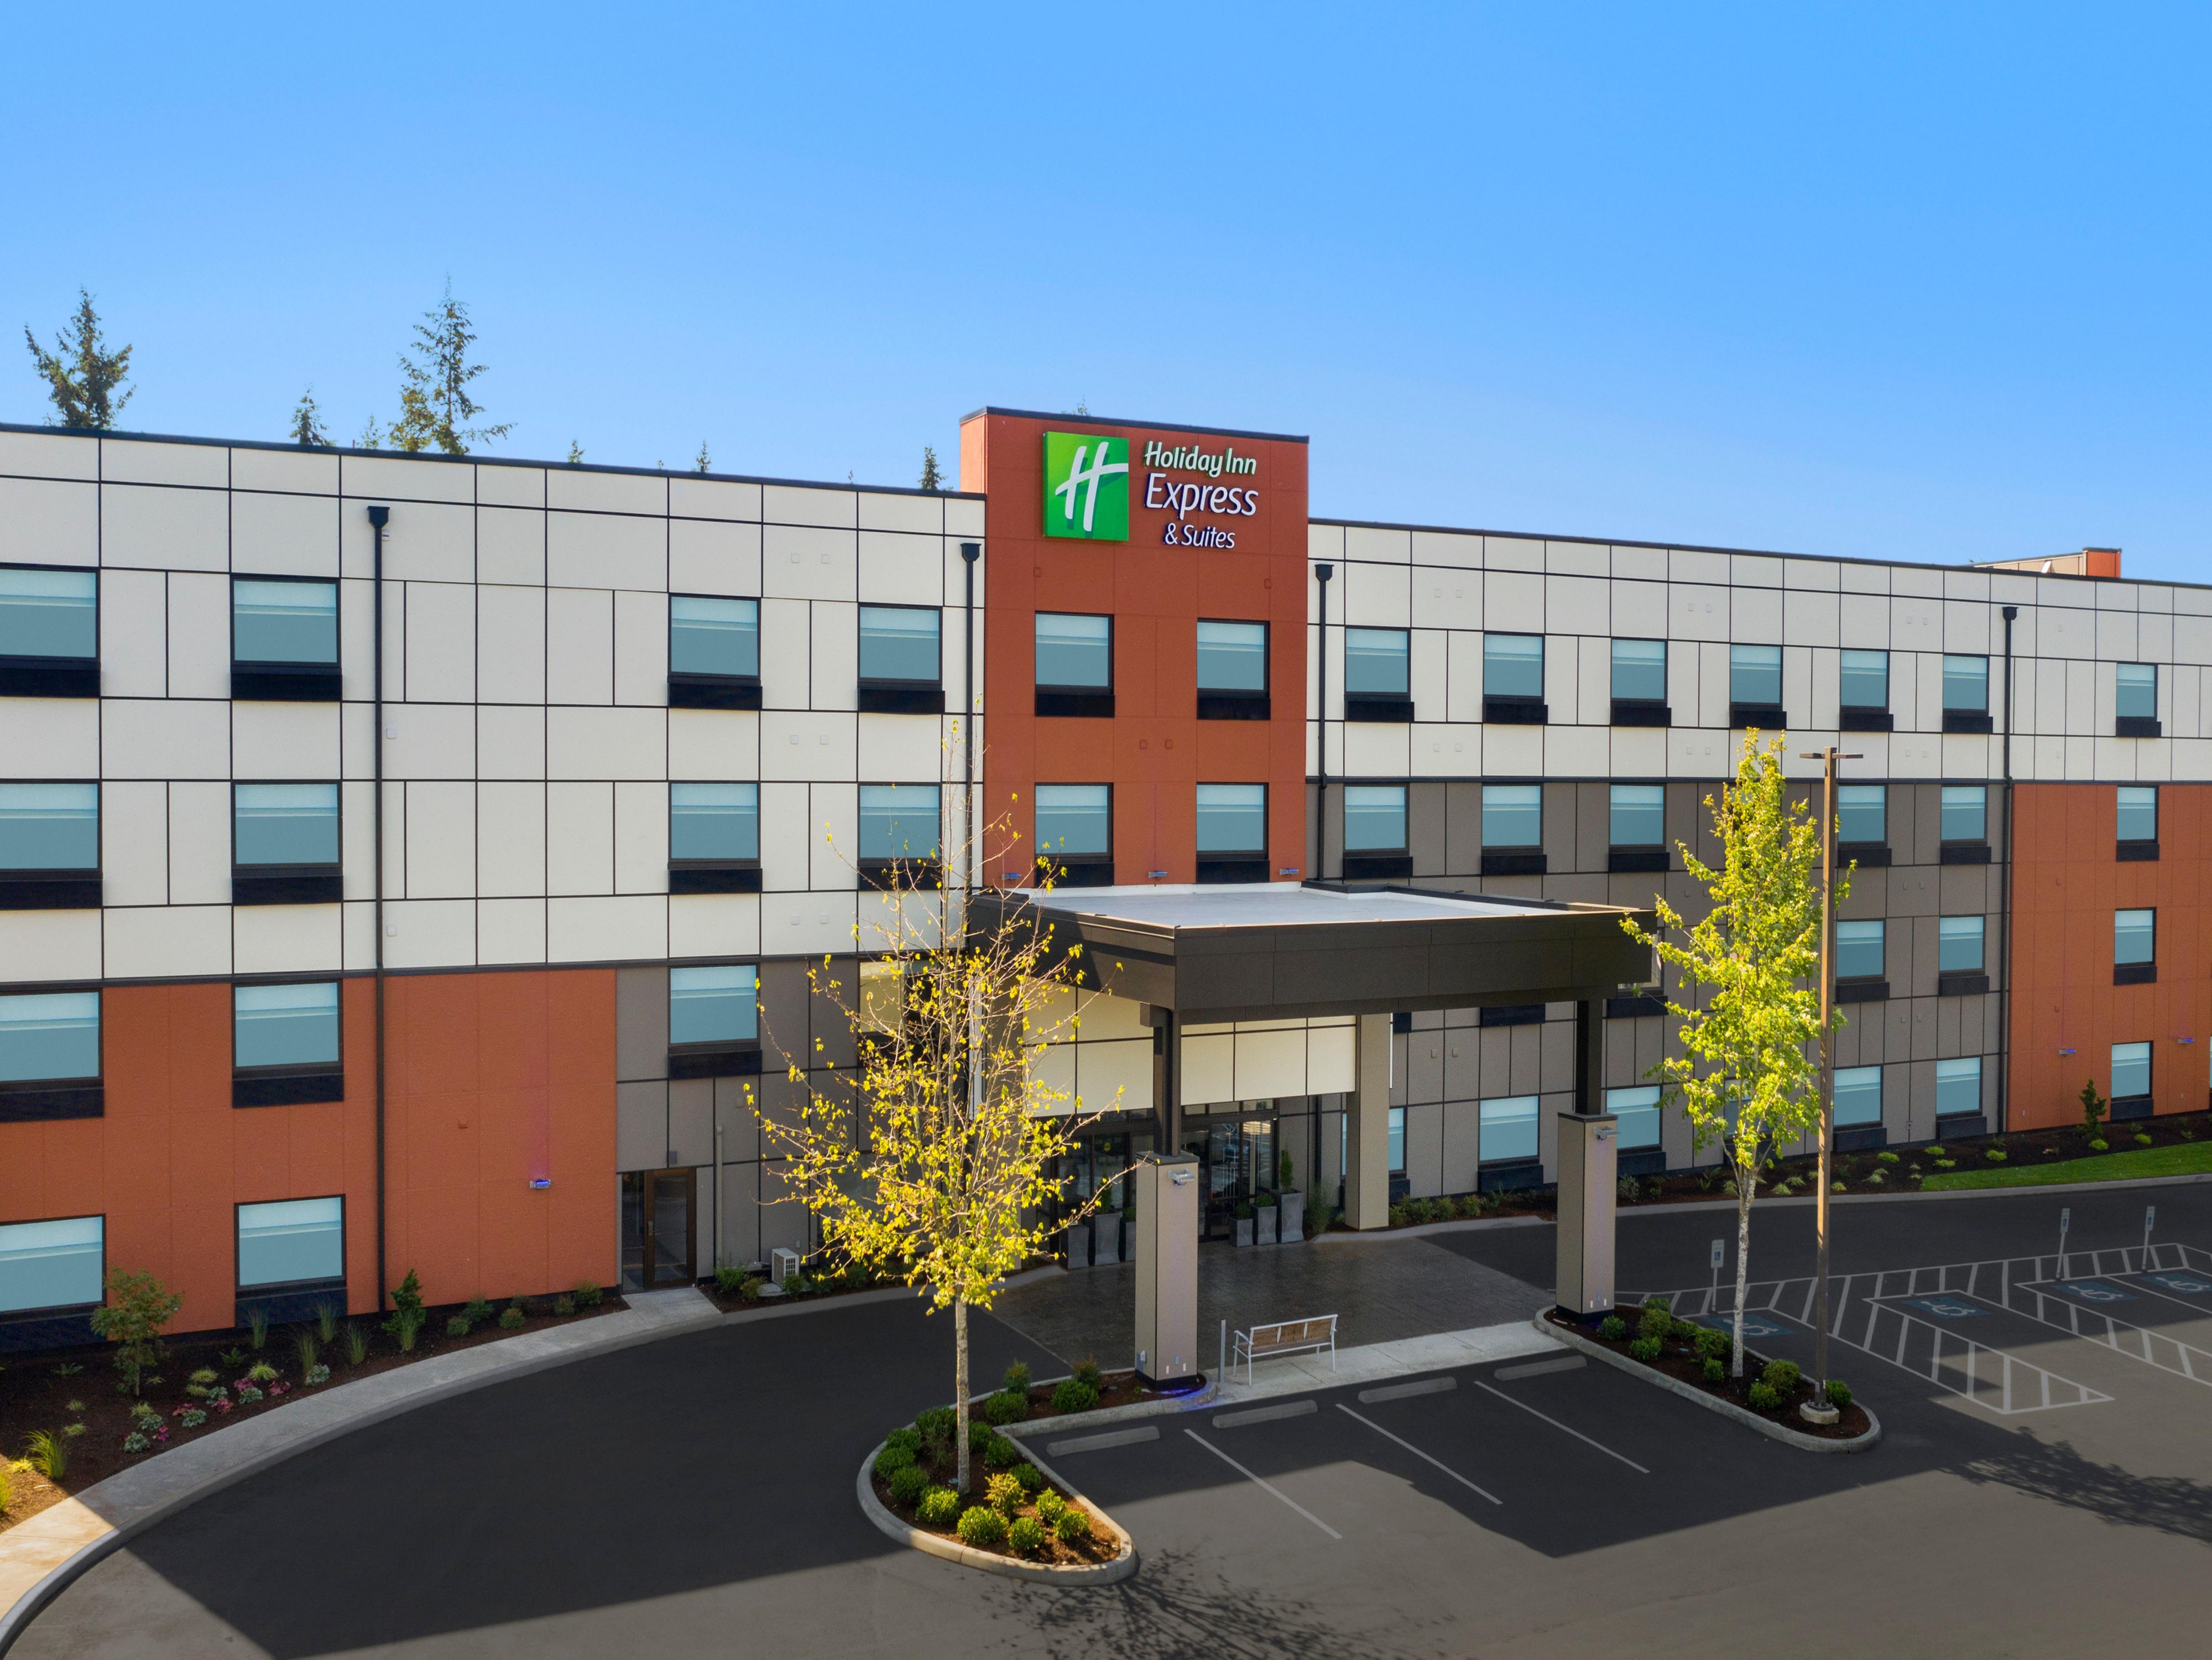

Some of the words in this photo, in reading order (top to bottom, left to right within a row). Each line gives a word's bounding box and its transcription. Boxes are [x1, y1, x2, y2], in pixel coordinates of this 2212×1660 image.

[1144, 441, 1222, 477] Holiday
[1226, 447, 1257, 475] Inn
[1145, 472, 1259, 520] Express
[1165, 523, 1178, 545] &
[1181, 524, 1235, 549] Suites
